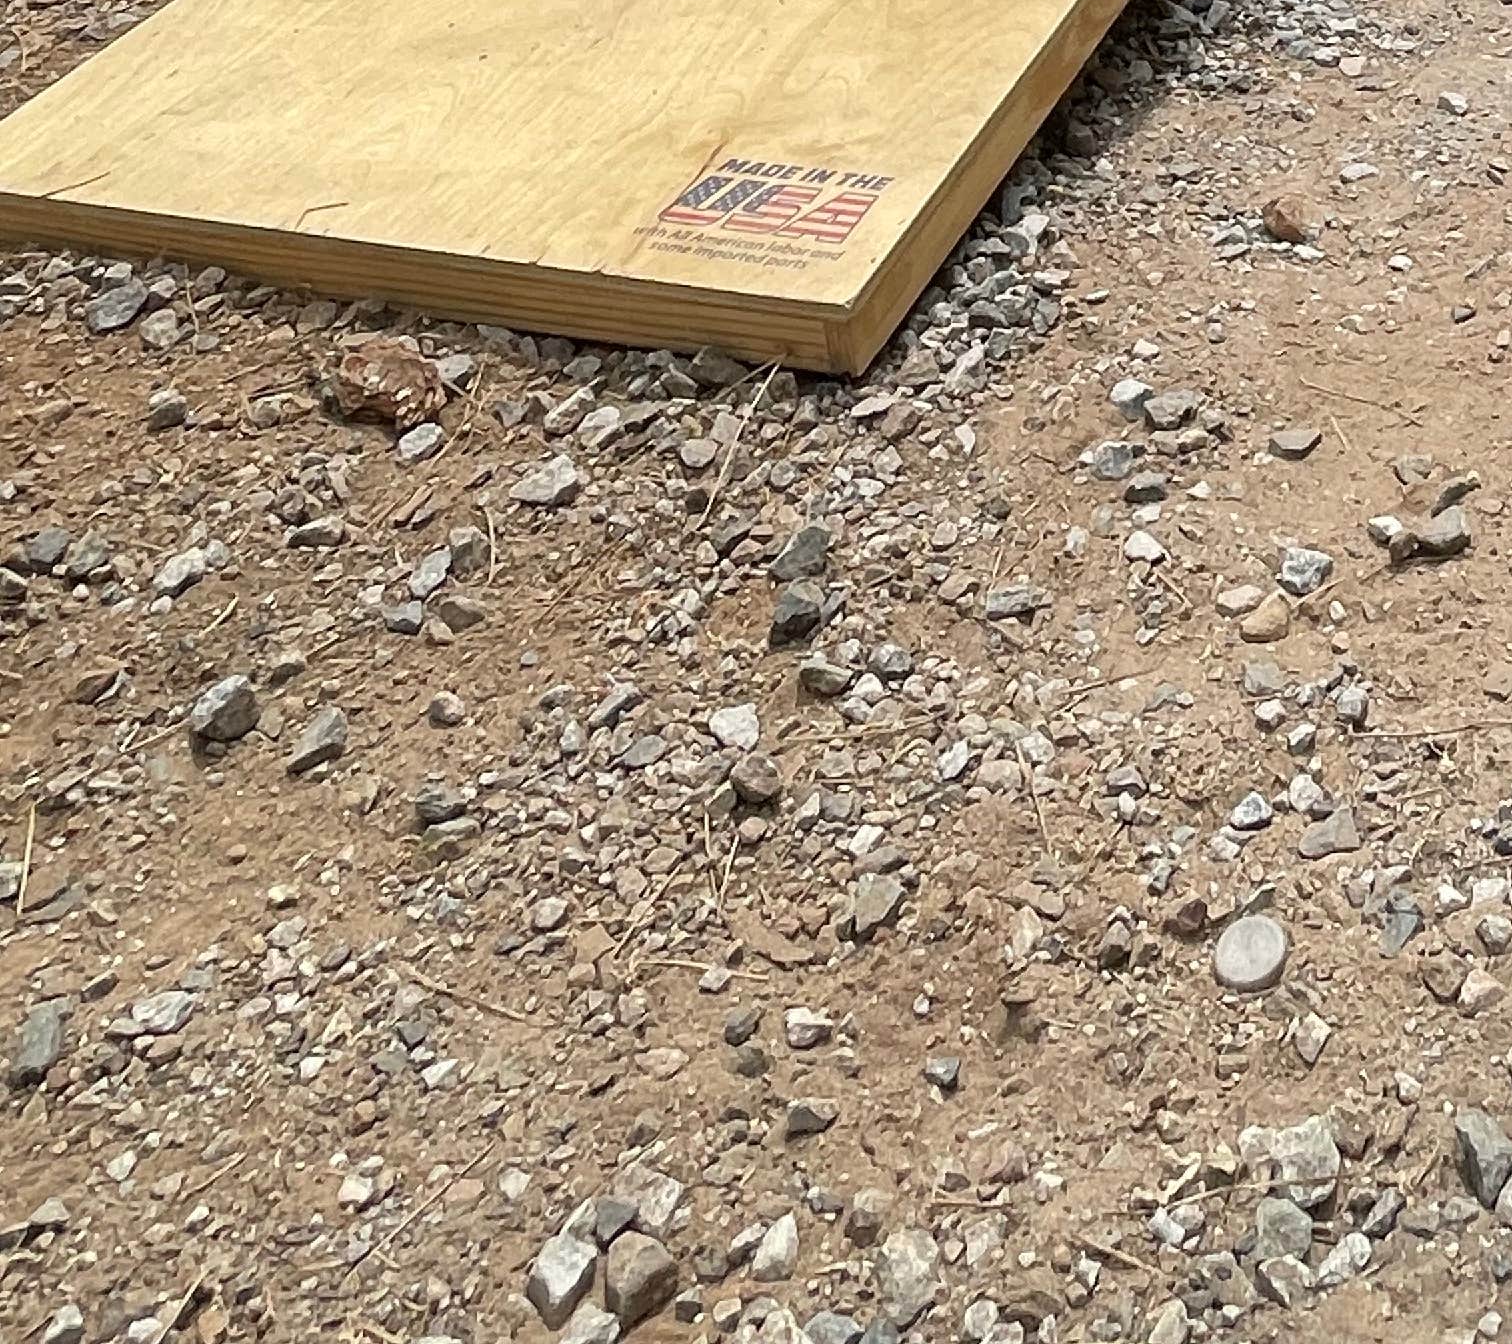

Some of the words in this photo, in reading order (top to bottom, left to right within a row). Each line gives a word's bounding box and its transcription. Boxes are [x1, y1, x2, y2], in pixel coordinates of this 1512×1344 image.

[716, 159, 803, 179] MADE
[799, 168, 837, 184] IN
[836, 172, 895, 191] THE
[658, 176, 879, 243] USA
[649, 241, 692, 254] some
[693, 246, 767, 263] imported
[763, 256, 808, 269] parts
[690, 233, 765, 250] American
[765, 241, 810, 255] labor
[810, 250, 845, 261] and
